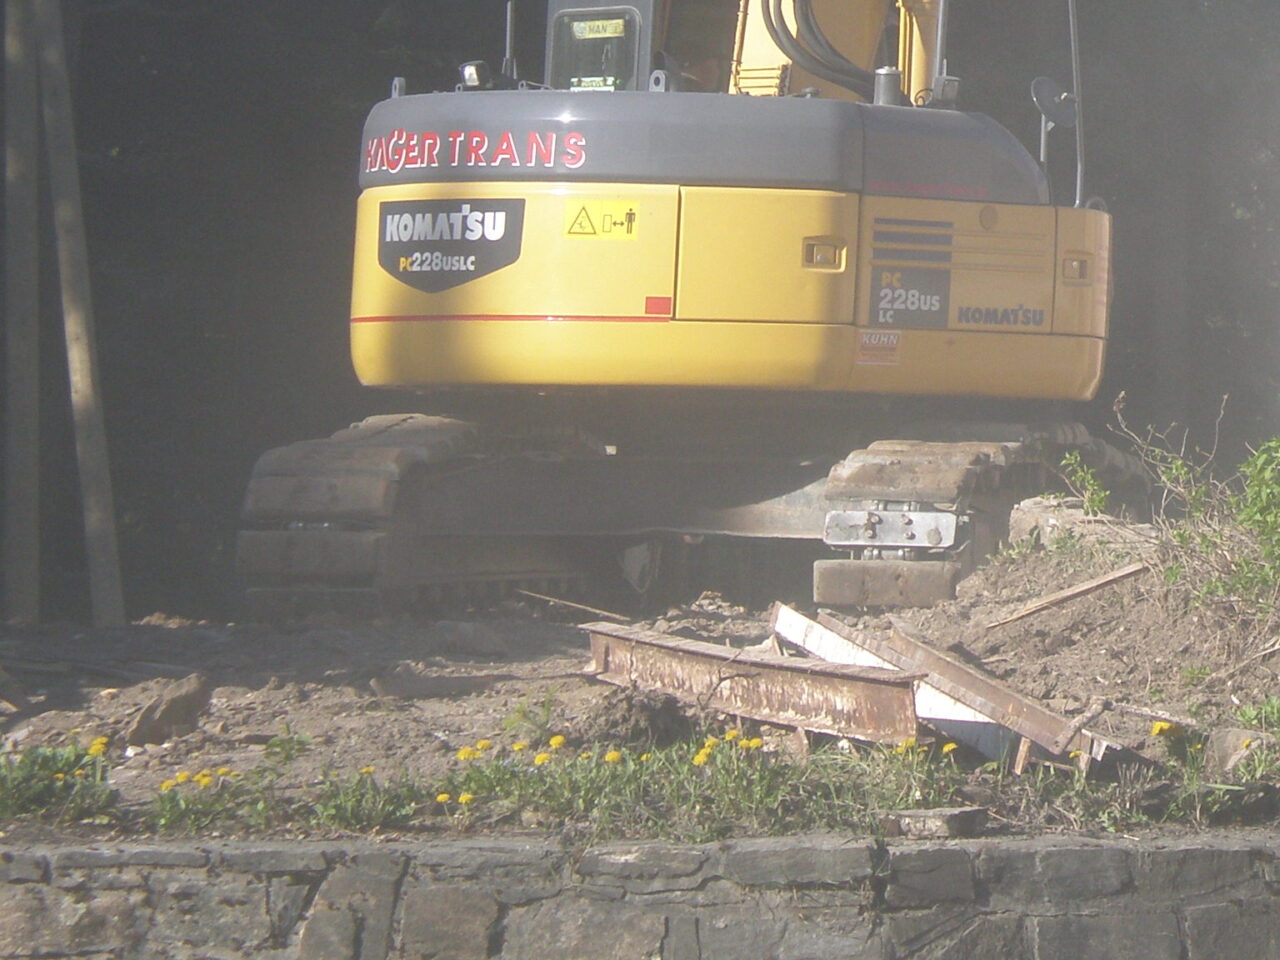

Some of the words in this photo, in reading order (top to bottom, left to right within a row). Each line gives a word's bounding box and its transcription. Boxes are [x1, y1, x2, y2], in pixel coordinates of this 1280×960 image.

[448, 131, 586, 168] TRANS
[385, 203, 506, 242] KOMATSU
[881, 271, 901, 287] PC
[878, 288, 940, 311] 228US
[878, 310, 894, 324] LC
[957, 304, 1044, 326] KOMATSU
[862, 334, 898, 345] KUHN
